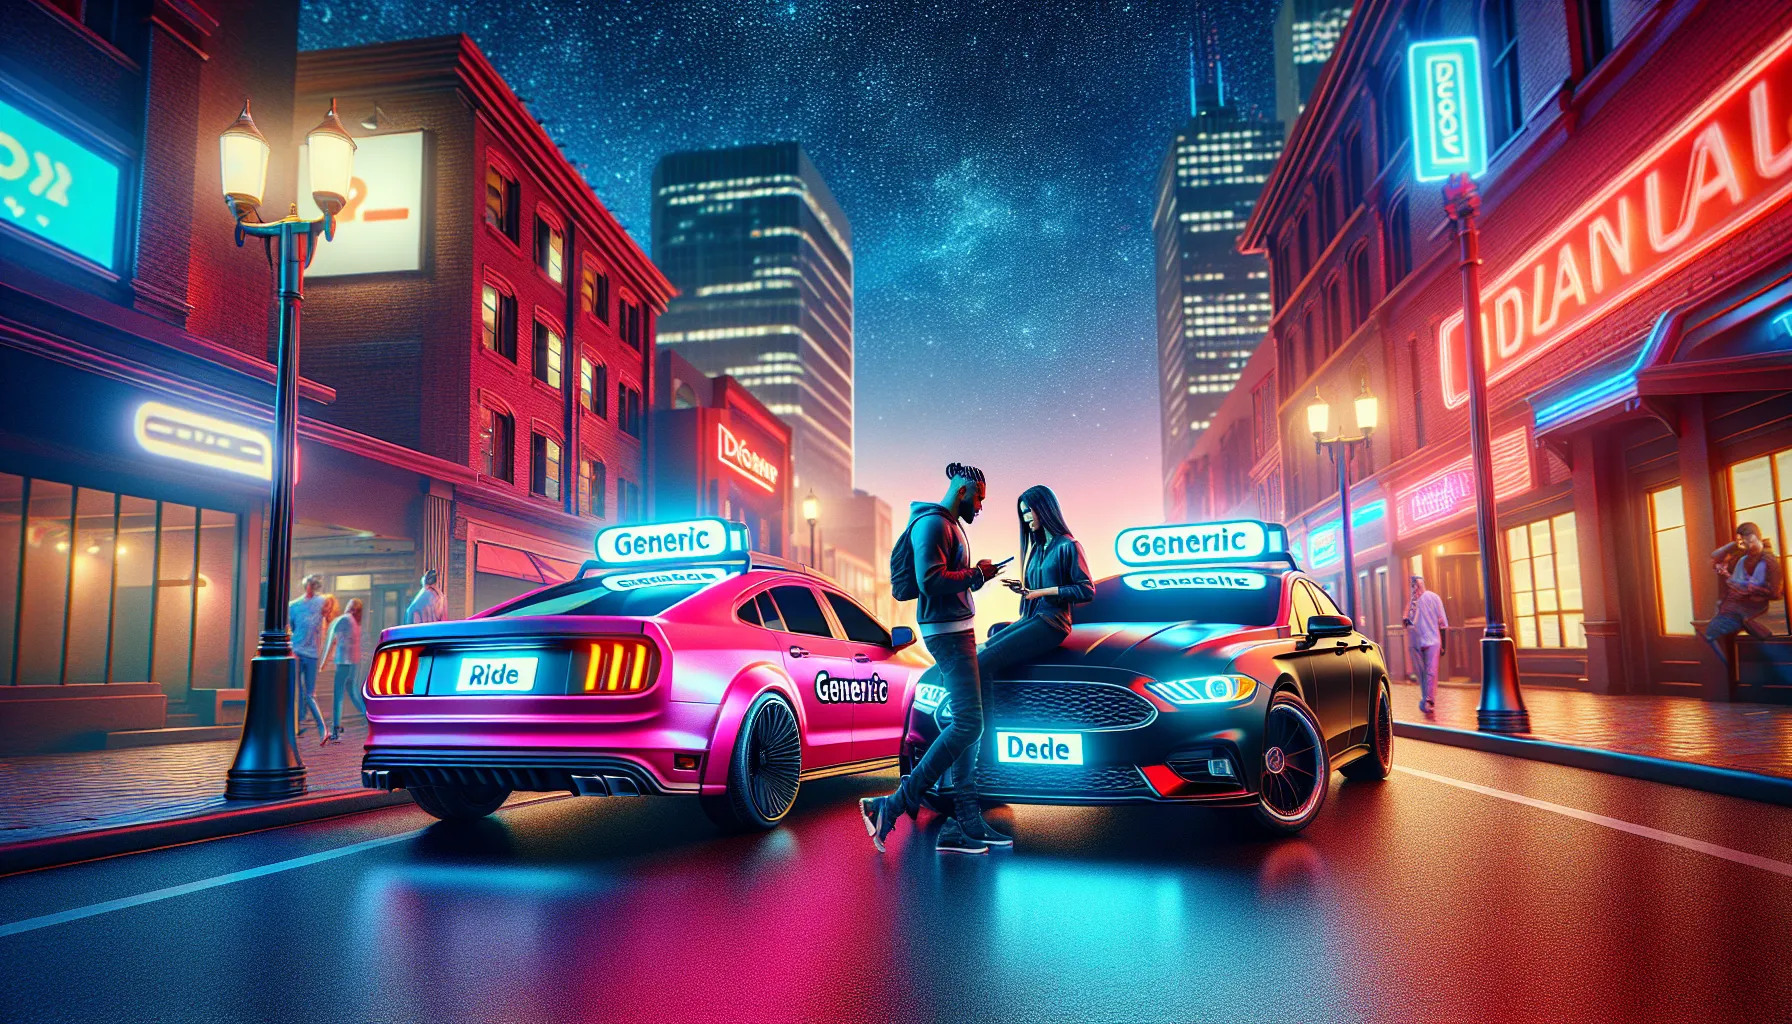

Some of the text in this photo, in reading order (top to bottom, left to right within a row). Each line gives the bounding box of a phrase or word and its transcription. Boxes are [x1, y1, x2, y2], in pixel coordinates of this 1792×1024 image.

[614, 527, 710, 556] Generic
[469, 663, 519, 686] Ride
[1007, 735, 1070, 760] Dede
